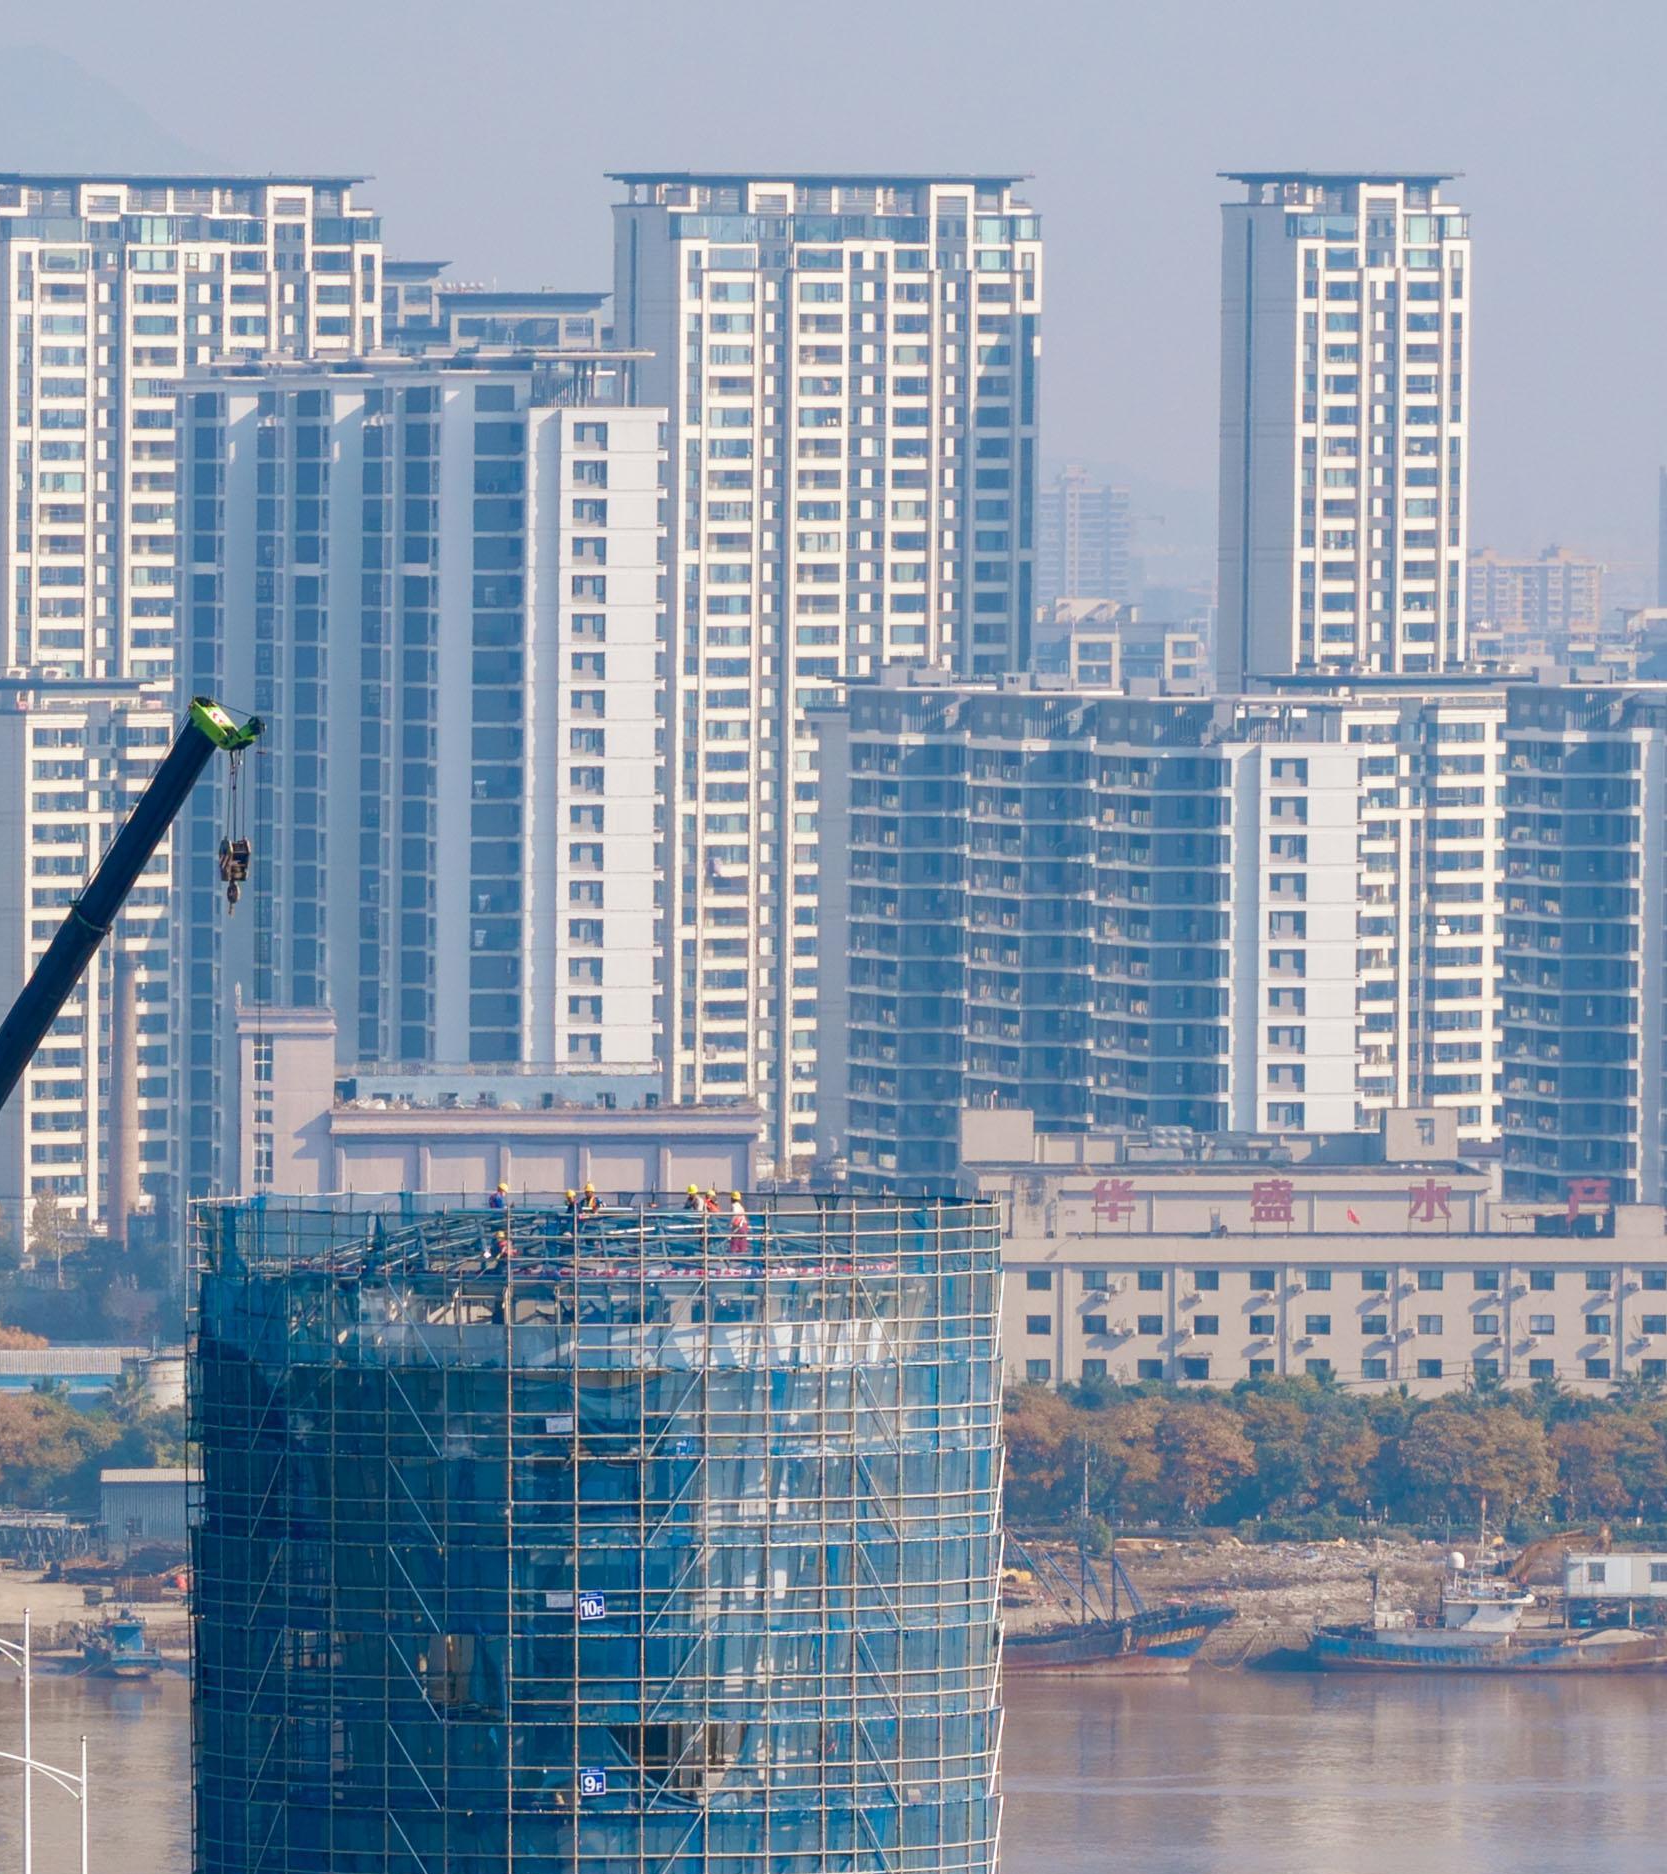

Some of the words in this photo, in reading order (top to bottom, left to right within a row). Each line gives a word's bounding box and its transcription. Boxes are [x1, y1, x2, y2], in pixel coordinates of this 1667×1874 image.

[1091, 1177, 1613, 1224] 华盛水产
[581, 1600, 604, 1617] 10F
[584, 1776, 603, 1792] 9F
